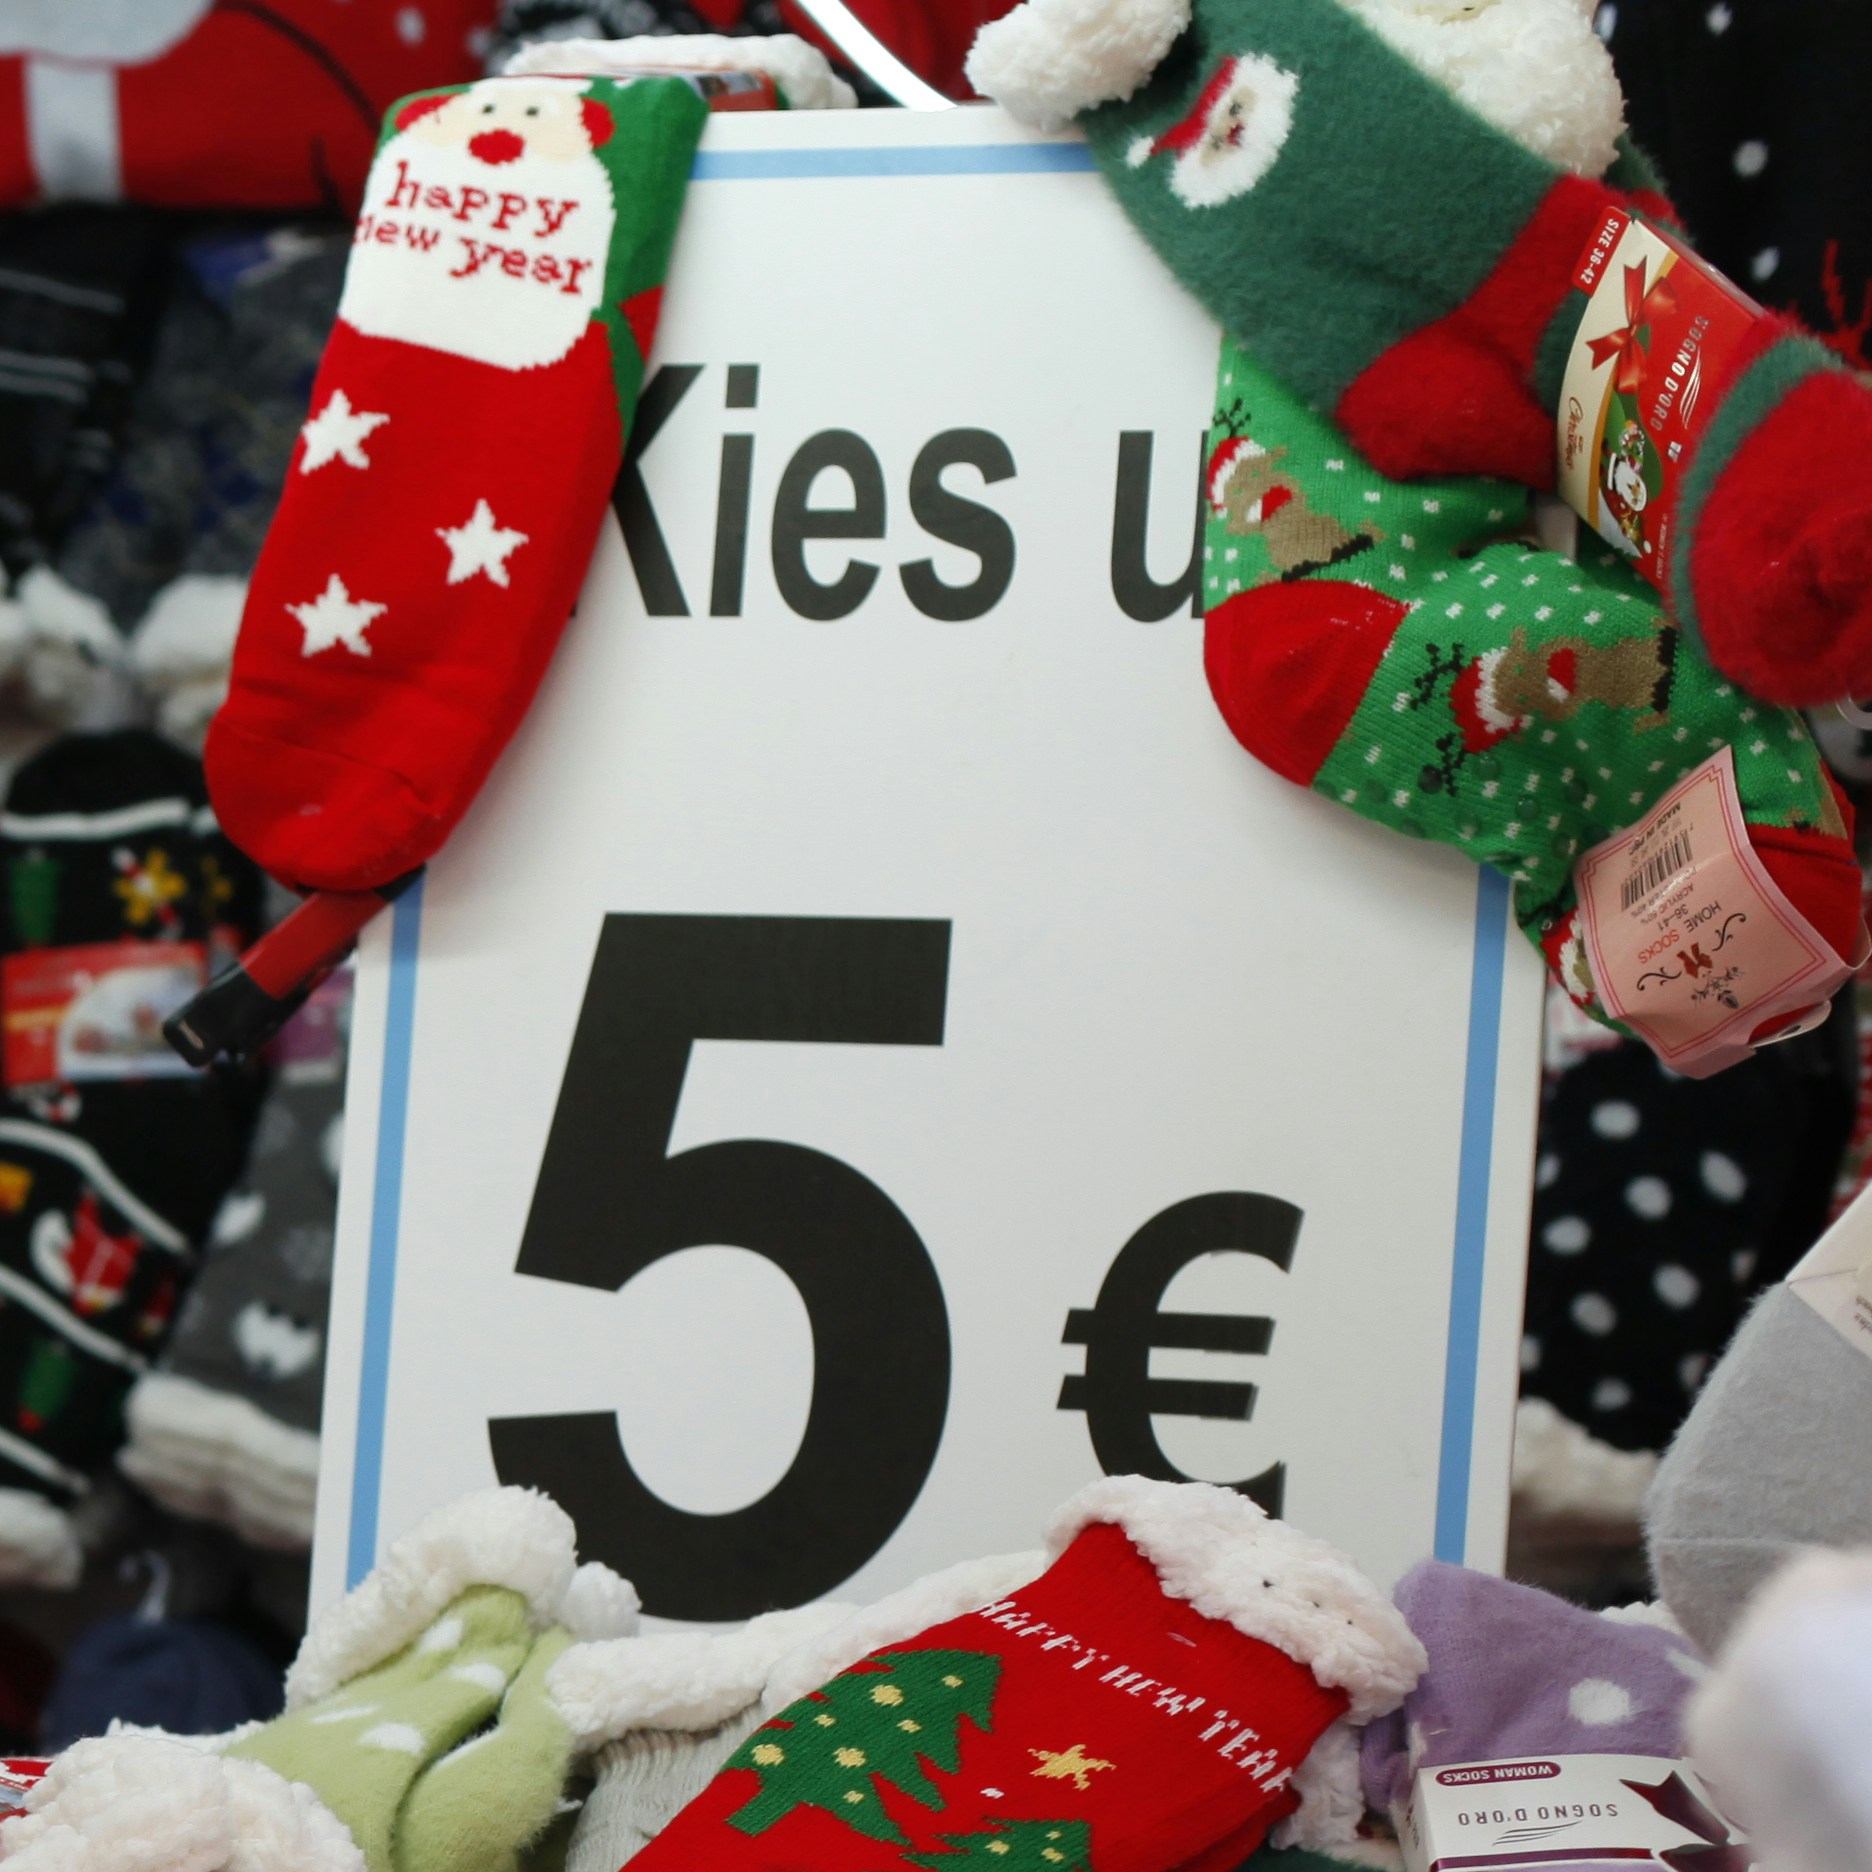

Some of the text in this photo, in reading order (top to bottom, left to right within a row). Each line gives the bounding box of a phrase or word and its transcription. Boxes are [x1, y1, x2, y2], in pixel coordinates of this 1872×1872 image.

[385, 160, 579, 238] happy
[450, 236, 594, 294] year
[1580, 217, 1620, 285] SIZE 36-42
[1637, 899, 1723, 964] HOME SOCKS
[486, 912, 1306, 1623] 5 €
[1443, 1764, 1553, 1783] WOMAN SOCKS
[1457, 1803, 1619, 1826] SOGNO D'ORO
